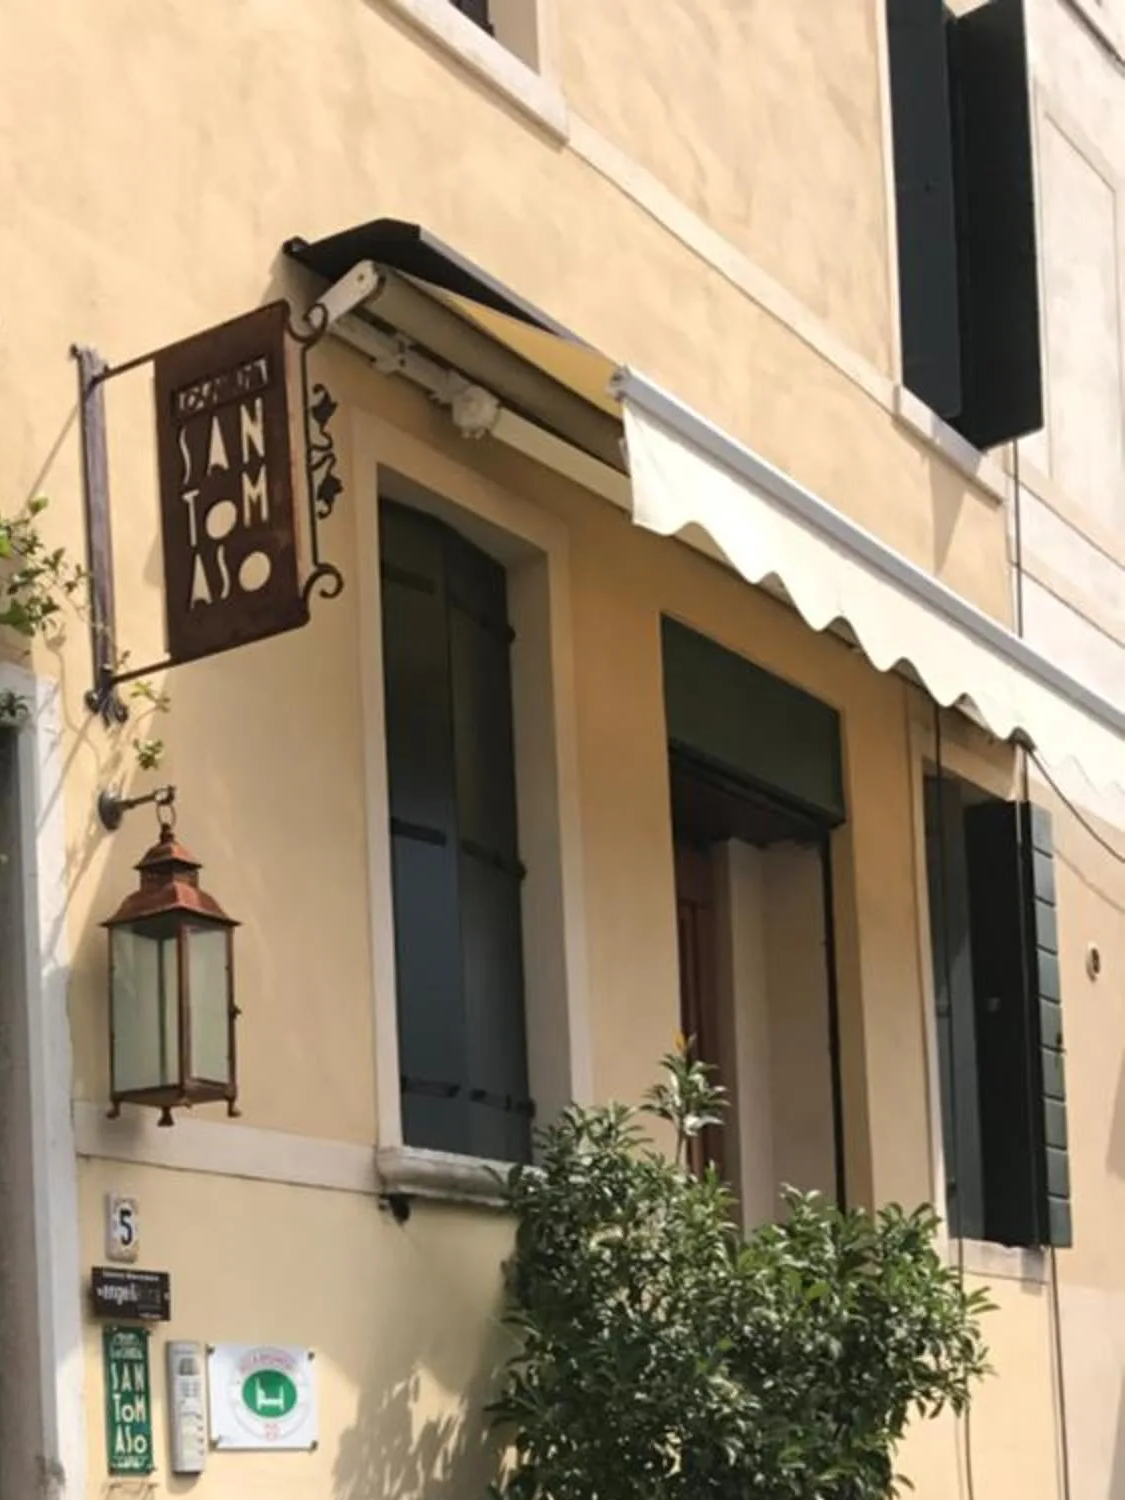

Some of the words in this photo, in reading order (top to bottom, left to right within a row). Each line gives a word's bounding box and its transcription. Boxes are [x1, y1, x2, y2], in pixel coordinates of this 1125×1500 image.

[179, 397, 266, 486] SAN
[182, 465, 268, 548] TOM
[190, 546, 271, 610] ASO
[119, 1208, 132, 1246] 5
